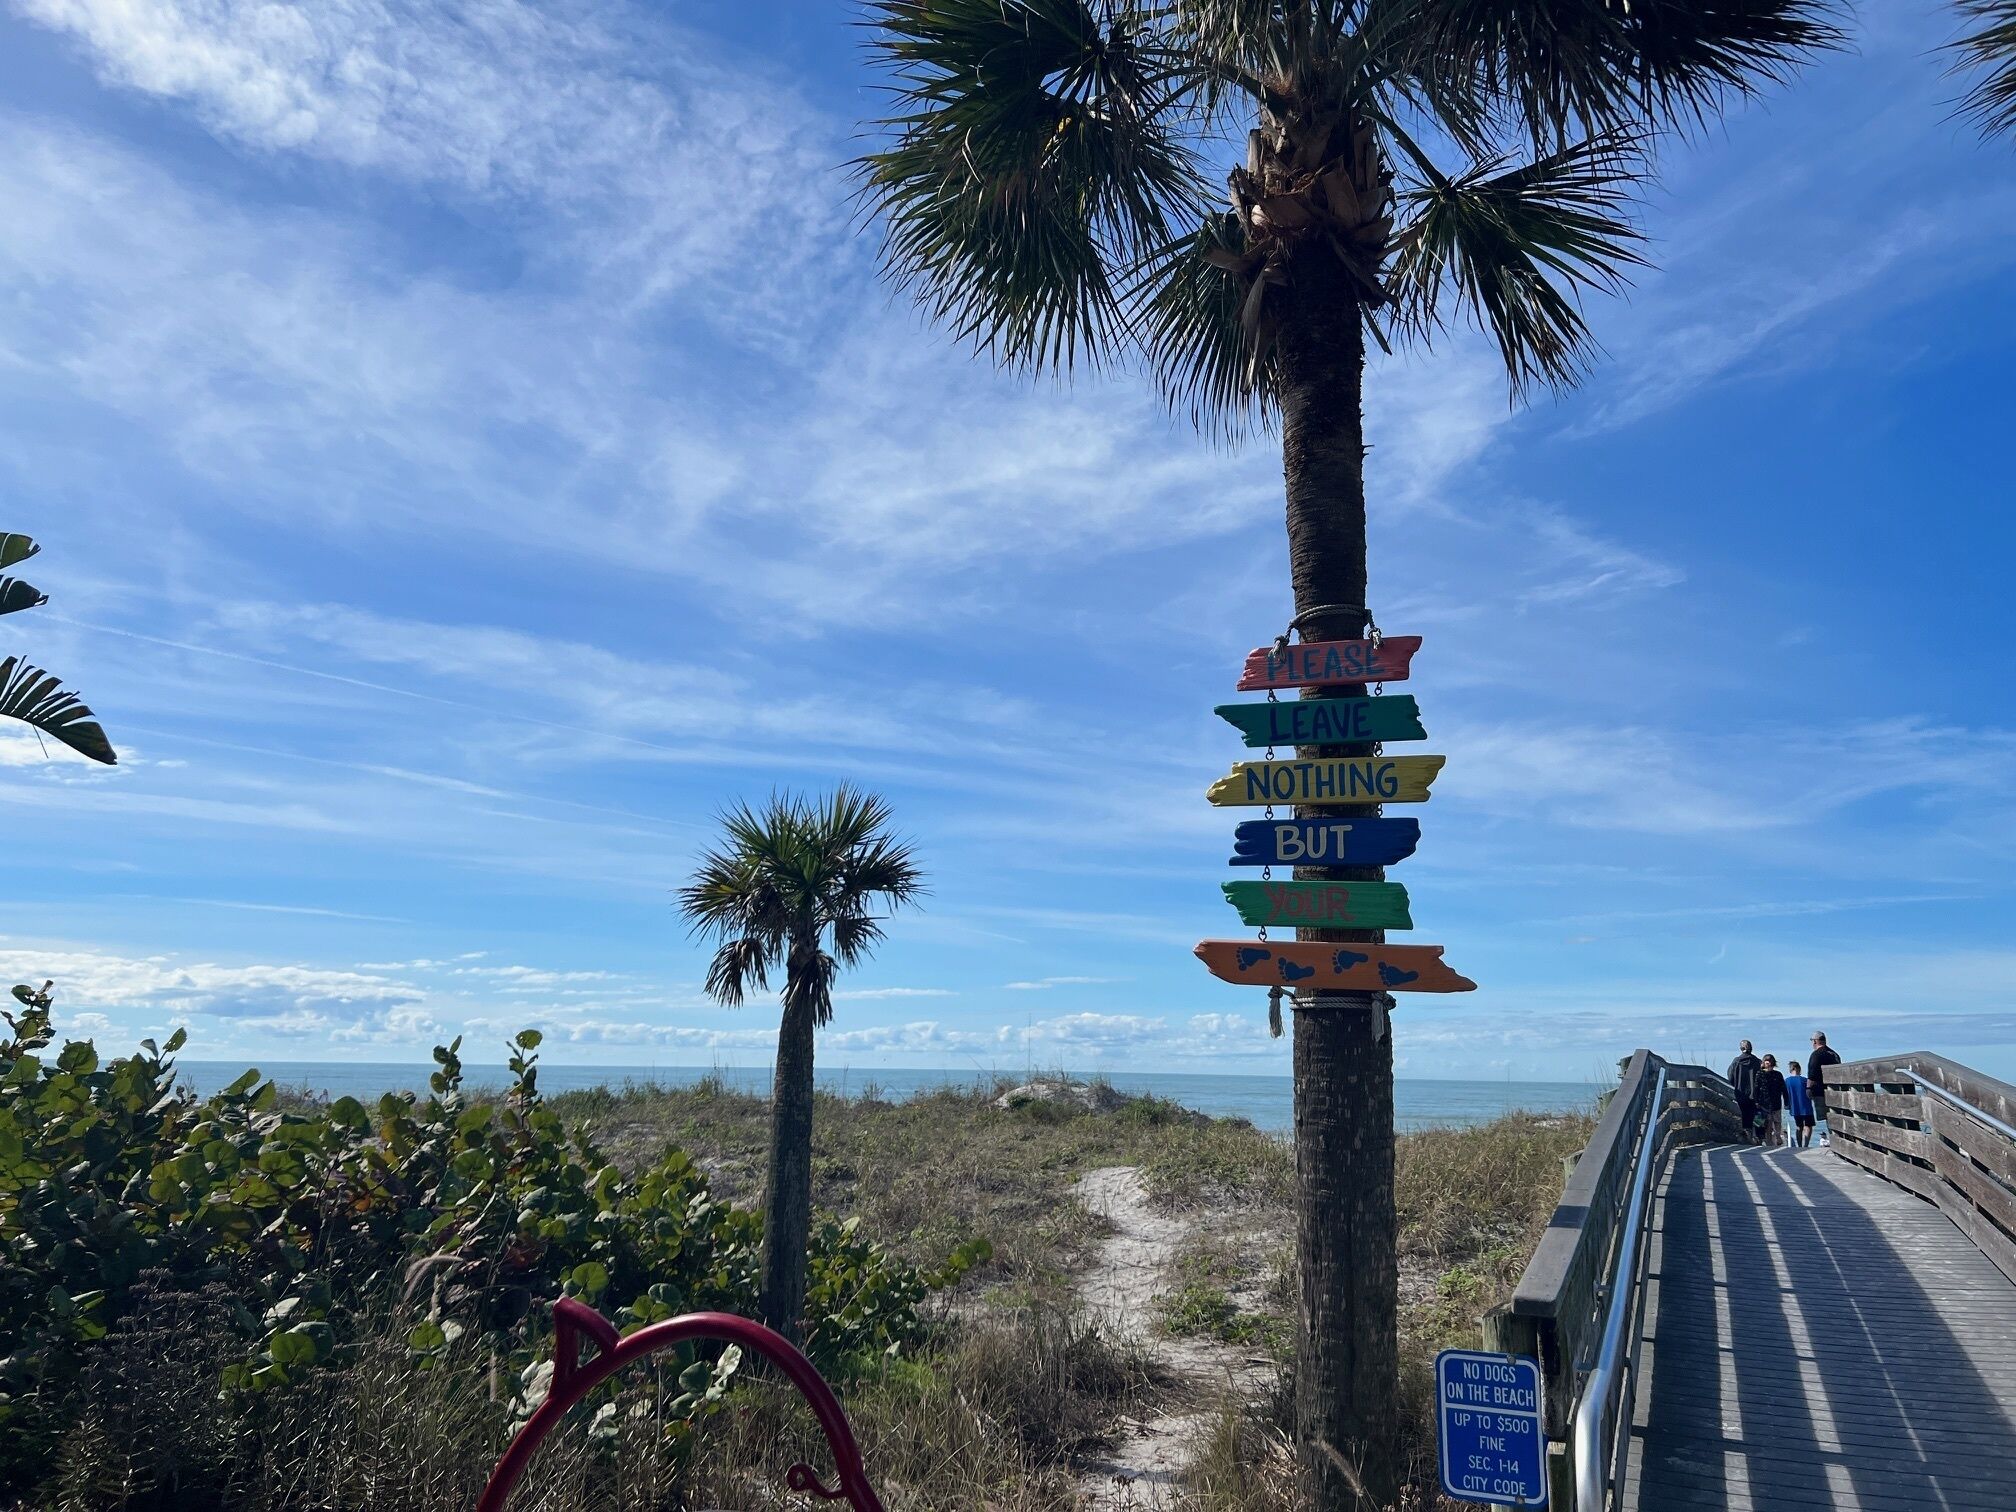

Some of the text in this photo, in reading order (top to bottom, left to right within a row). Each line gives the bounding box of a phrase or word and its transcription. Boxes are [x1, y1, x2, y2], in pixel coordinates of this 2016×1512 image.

[1269, 702, 1374, 742] LEAVE
[1246, 762, 1398, 800] NOTHING
[1274, 825, 1353, 861] BUT
[1264, 884, 1356, 922] YOUR
[1463, 1361, 1516, 1383] NO DOGS
[1447, 1382, 1534, 1407] ON THE BEACH
[1454, 1412, 1529, 1434] UP TO $500
[1479, 1435, 1506, 1452] FINE
[1468, 1455, 1519, 1474] SEC. 1-14
[1463, 1475, 1527, 1496] CITY CODE
